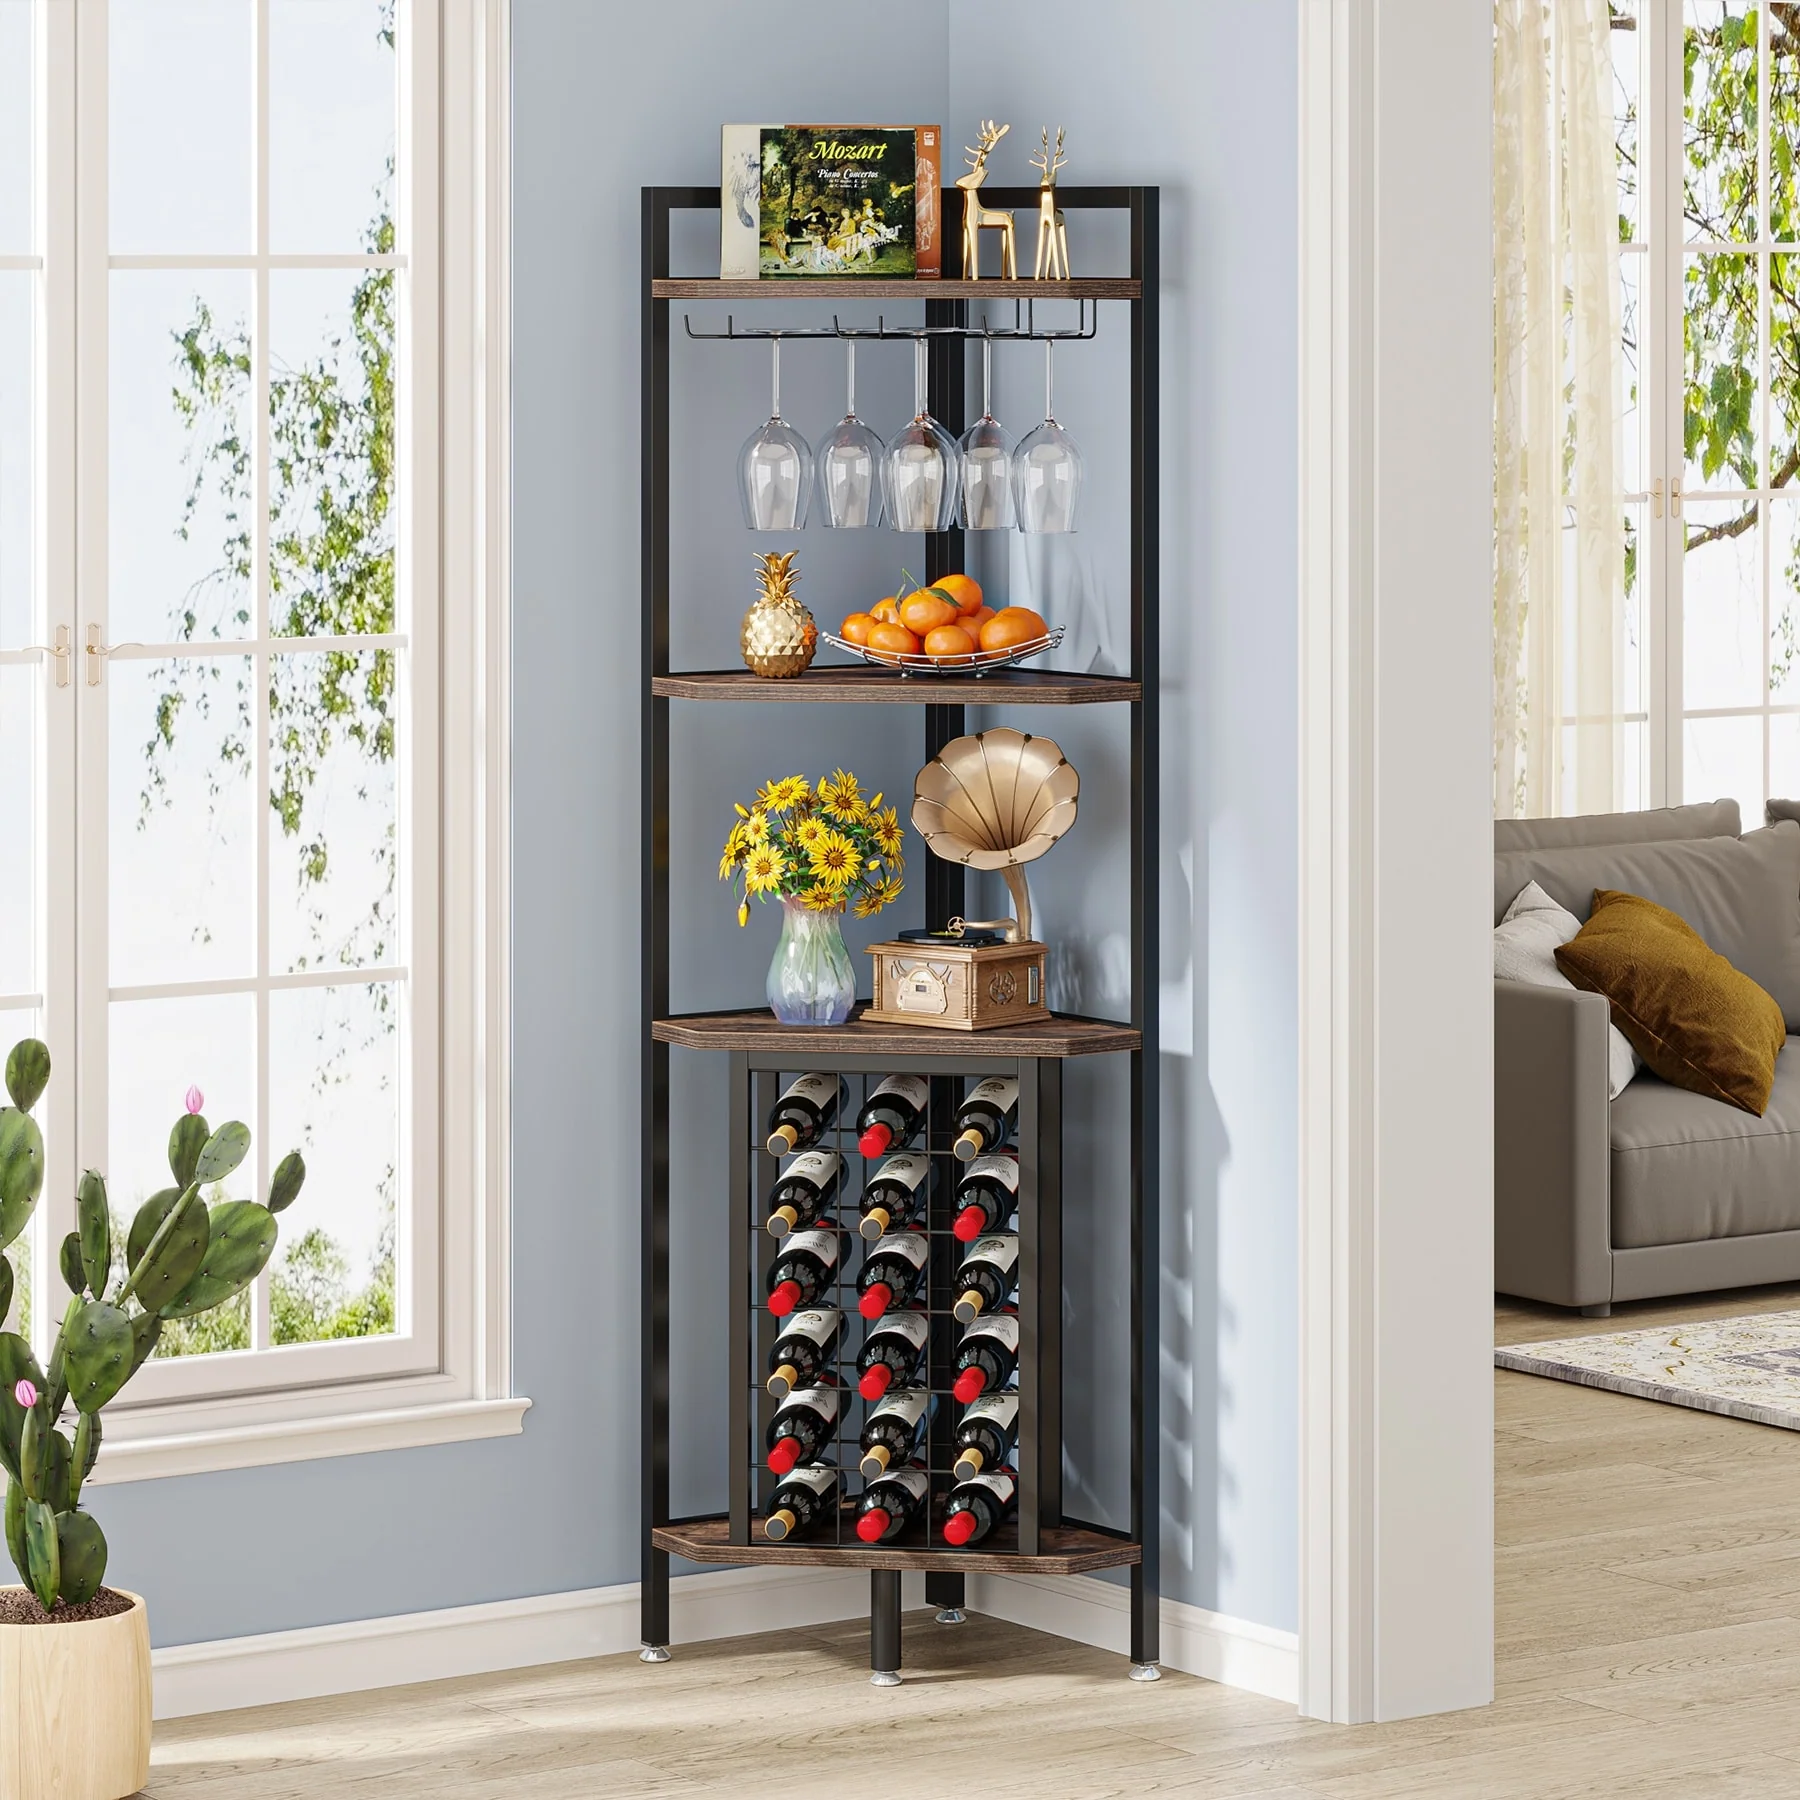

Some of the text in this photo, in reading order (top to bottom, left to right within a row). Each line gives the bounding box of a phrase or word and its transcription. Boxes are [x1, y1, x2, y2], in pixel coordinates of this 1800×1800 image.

[808, 141, 887, 160] Mozart
[817, 168, 879, 180] Piano Concertos
